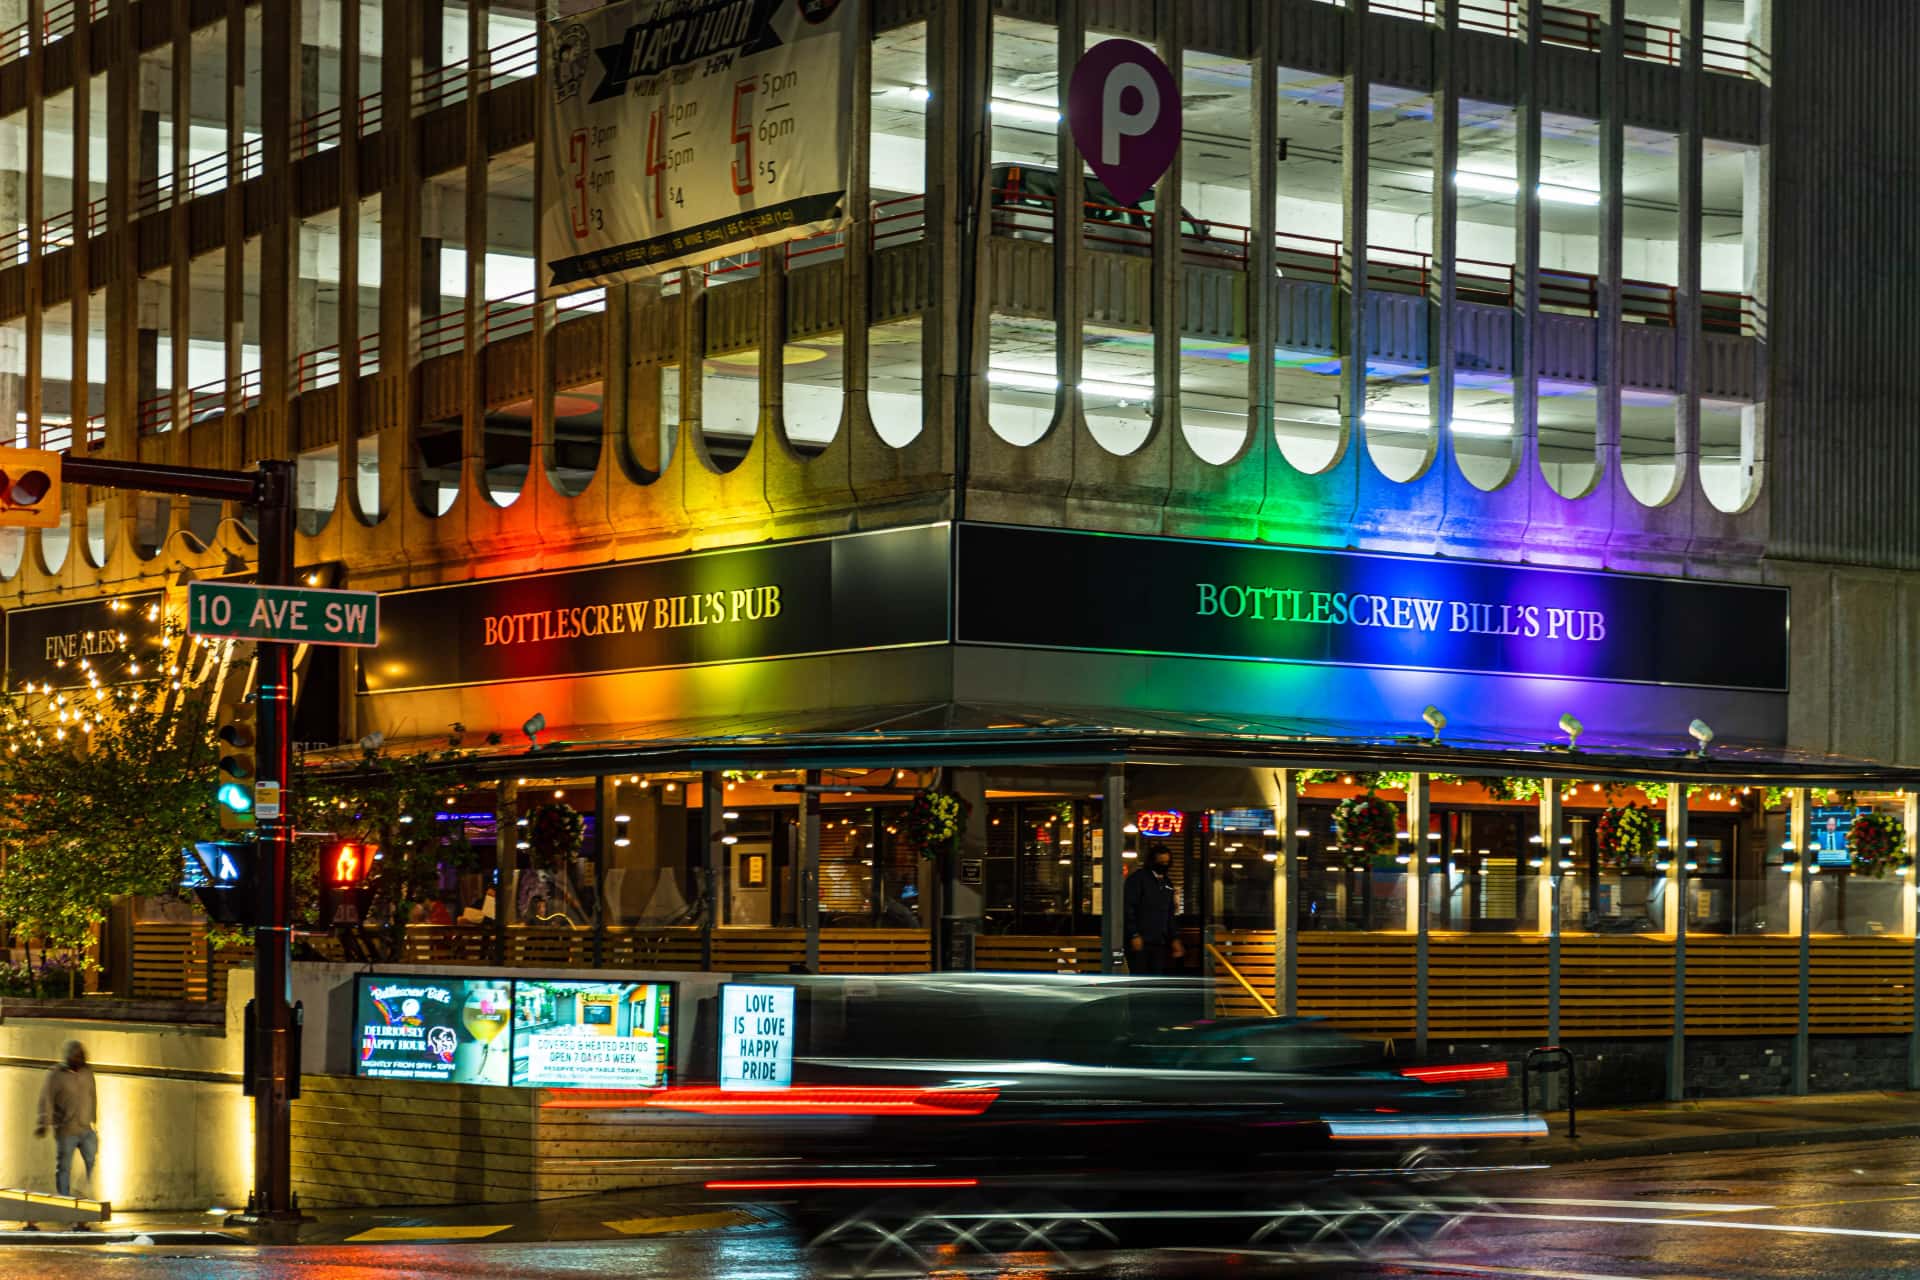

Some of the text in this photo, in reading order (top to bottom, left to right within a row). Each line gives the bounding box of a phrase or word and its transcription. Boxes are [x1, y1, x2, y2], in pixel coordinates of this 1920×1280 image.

[629, 16, 701, 73] HAPPY
[696, 0, 756, 55] HOUR
[761, 71, 798, 98] 5pm
[668, 102, 697, 127] 4pm
[1102, 62, 1160, 165] P
[591, 126, 617, 148] 3pm
[731, 75, 757, 195] 5
[759, 117, 794, 145] 6pm
[645, 104, 667, 219] 4
[668, 147, 694, 173] 5pm
[569, 127, 589, 239] 3
[589, 169, 615, 192] 4pm
[759, 160, 776, 184] $5
[670, 186, 684, 208] $4
[590, 208, 604, 231] $3
[198, 594, 368, 634] 10 AVE SW
[483, 585, 782, 646] BOTTLESCREW BILL'S PUB
[1195, 583, 1606, 642] BOTTLESCREW BILL'S PUB
[46, 629, 116, 660] FINE ALES
[1138, 813, 1184, 833] OPEN
[746, 994, 774, 1013] LOVE
[364, 1025, 426, 1038] DELIRIOUSLY
[734, 1016, 785, 1036] IS LOVE
[362, 1038, 427, 1051] HAPPY HOUR
[538, 1039, 577, 1051] COVERED
[585, 1040, 617, 1052] HEATED
[620, 1041, 648, 1052] PATIOS
[740, 1039, 779, 1058] HAPPY
[393, 1061, 415, 1069] FROM
[549, 1052, 636, 1064] OPEN 7 DAYS A WEEK
[742, 1061, 776, 1080] PRIDE
